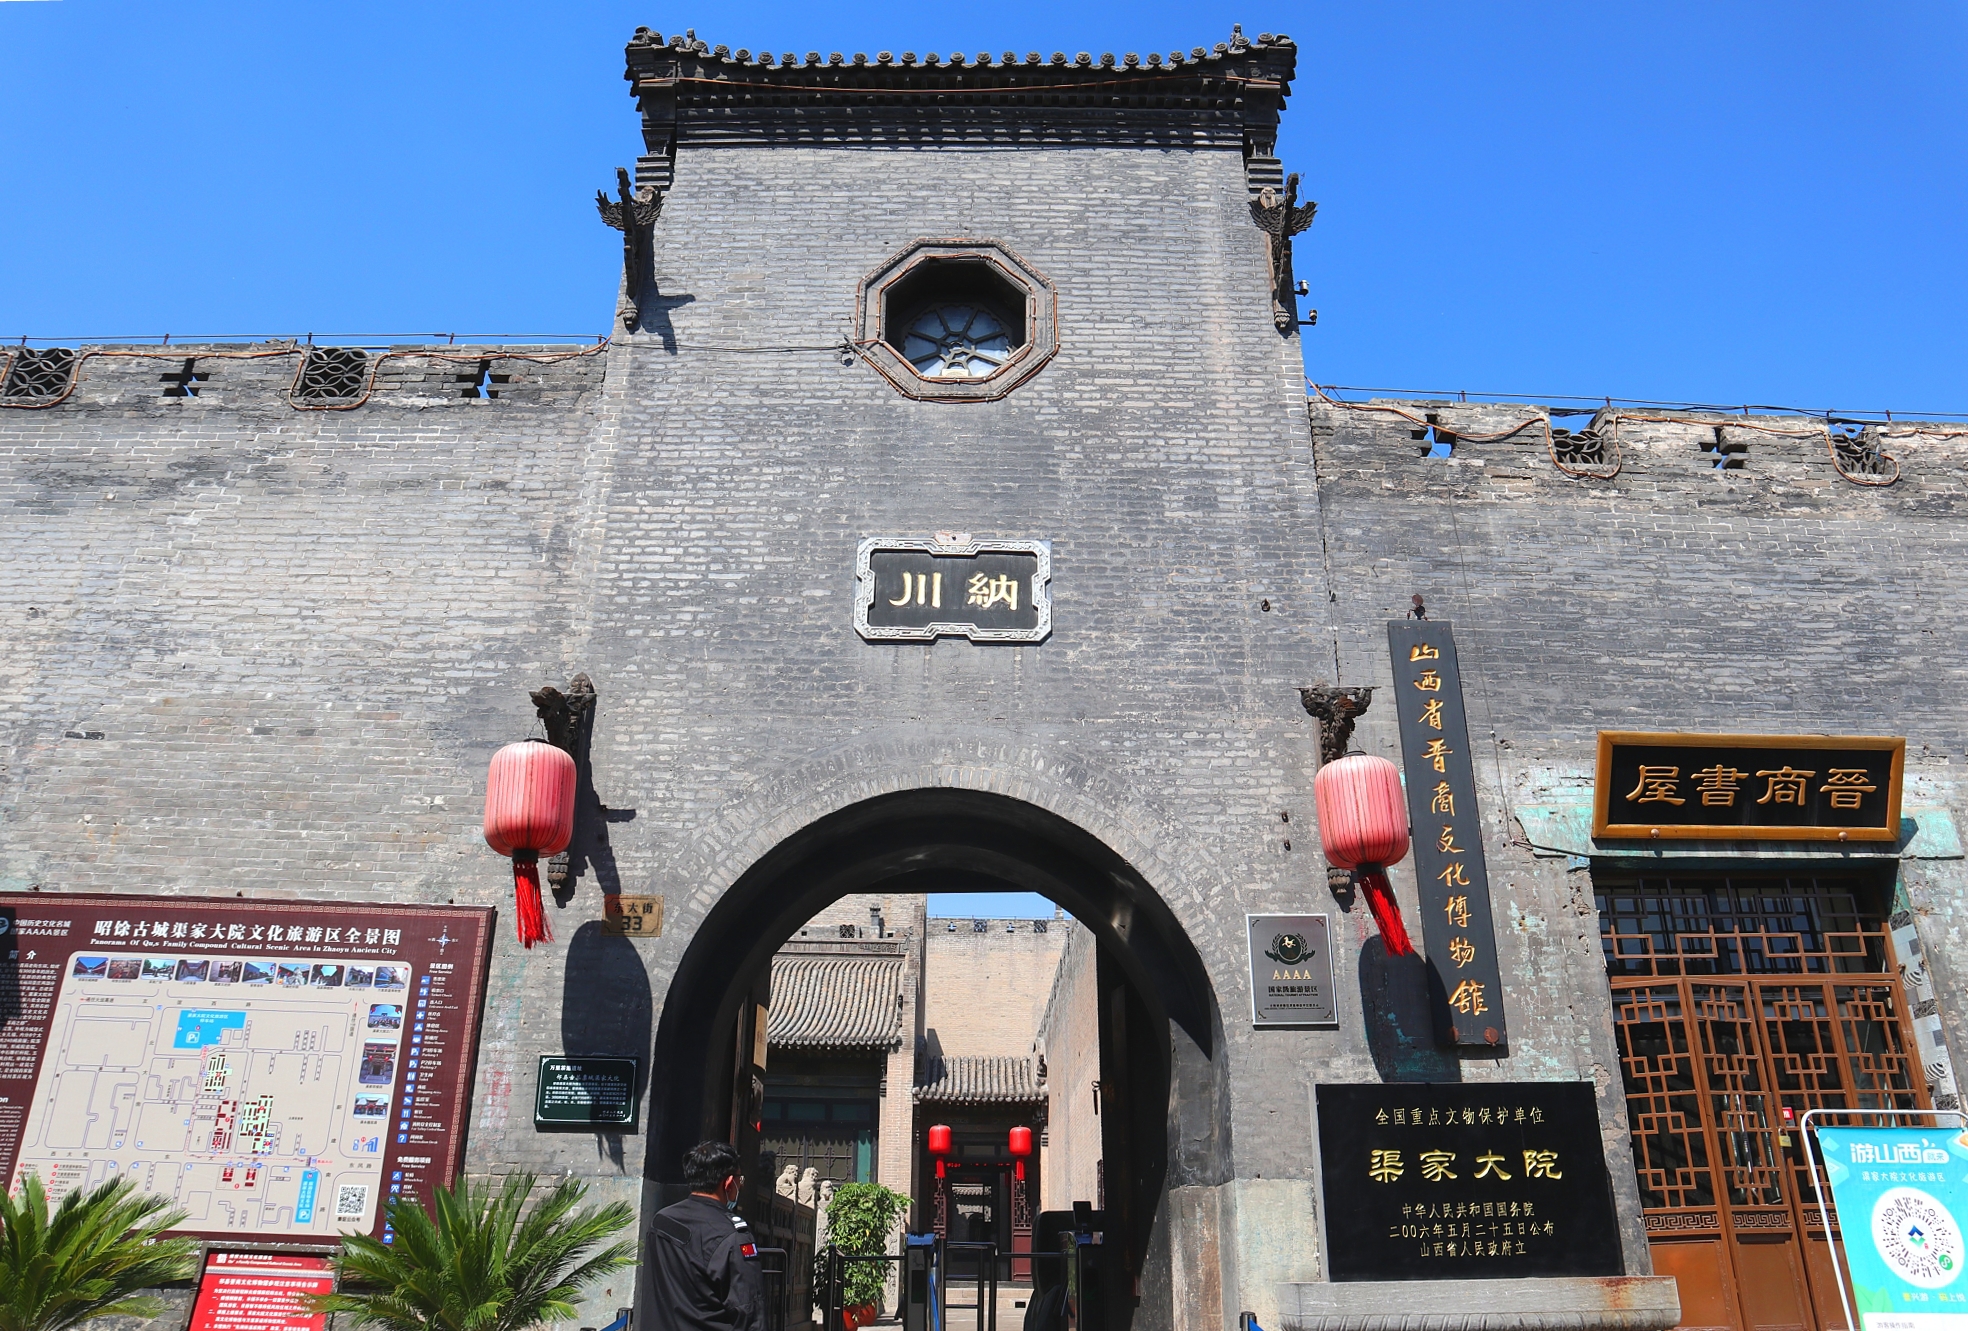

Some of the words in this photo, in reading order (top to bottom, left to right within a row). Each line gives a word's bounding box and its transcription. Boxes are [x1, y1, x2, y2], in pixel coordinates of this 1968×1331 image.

[614, 902, 653, 914] 东大街
[621, 916, 643, 930] 33
[90, 938, 126, 946] Panorama
[162, 941, 188, 949] Family
[189, 942, 228, 950] Compound
[322, 946, 350, 954] Zhaoyu
[381, 947, 398, 955] City
[1273, 969, 1312, 980] AAAA
[1268, 985, 1318, 994] 国家级旅游景区
[1375, 1106, 1545, 1126] 全国重点文物保护单位
[1850, 1142, 1922, 1164] 游山西
[1368, 1149, 1562, 1184] 渠家大院
[1402, 1202, 1536, 1220] 中华人民共和国国务院
[1419, 1240, 1527, 1257] 山西省人民政府立
